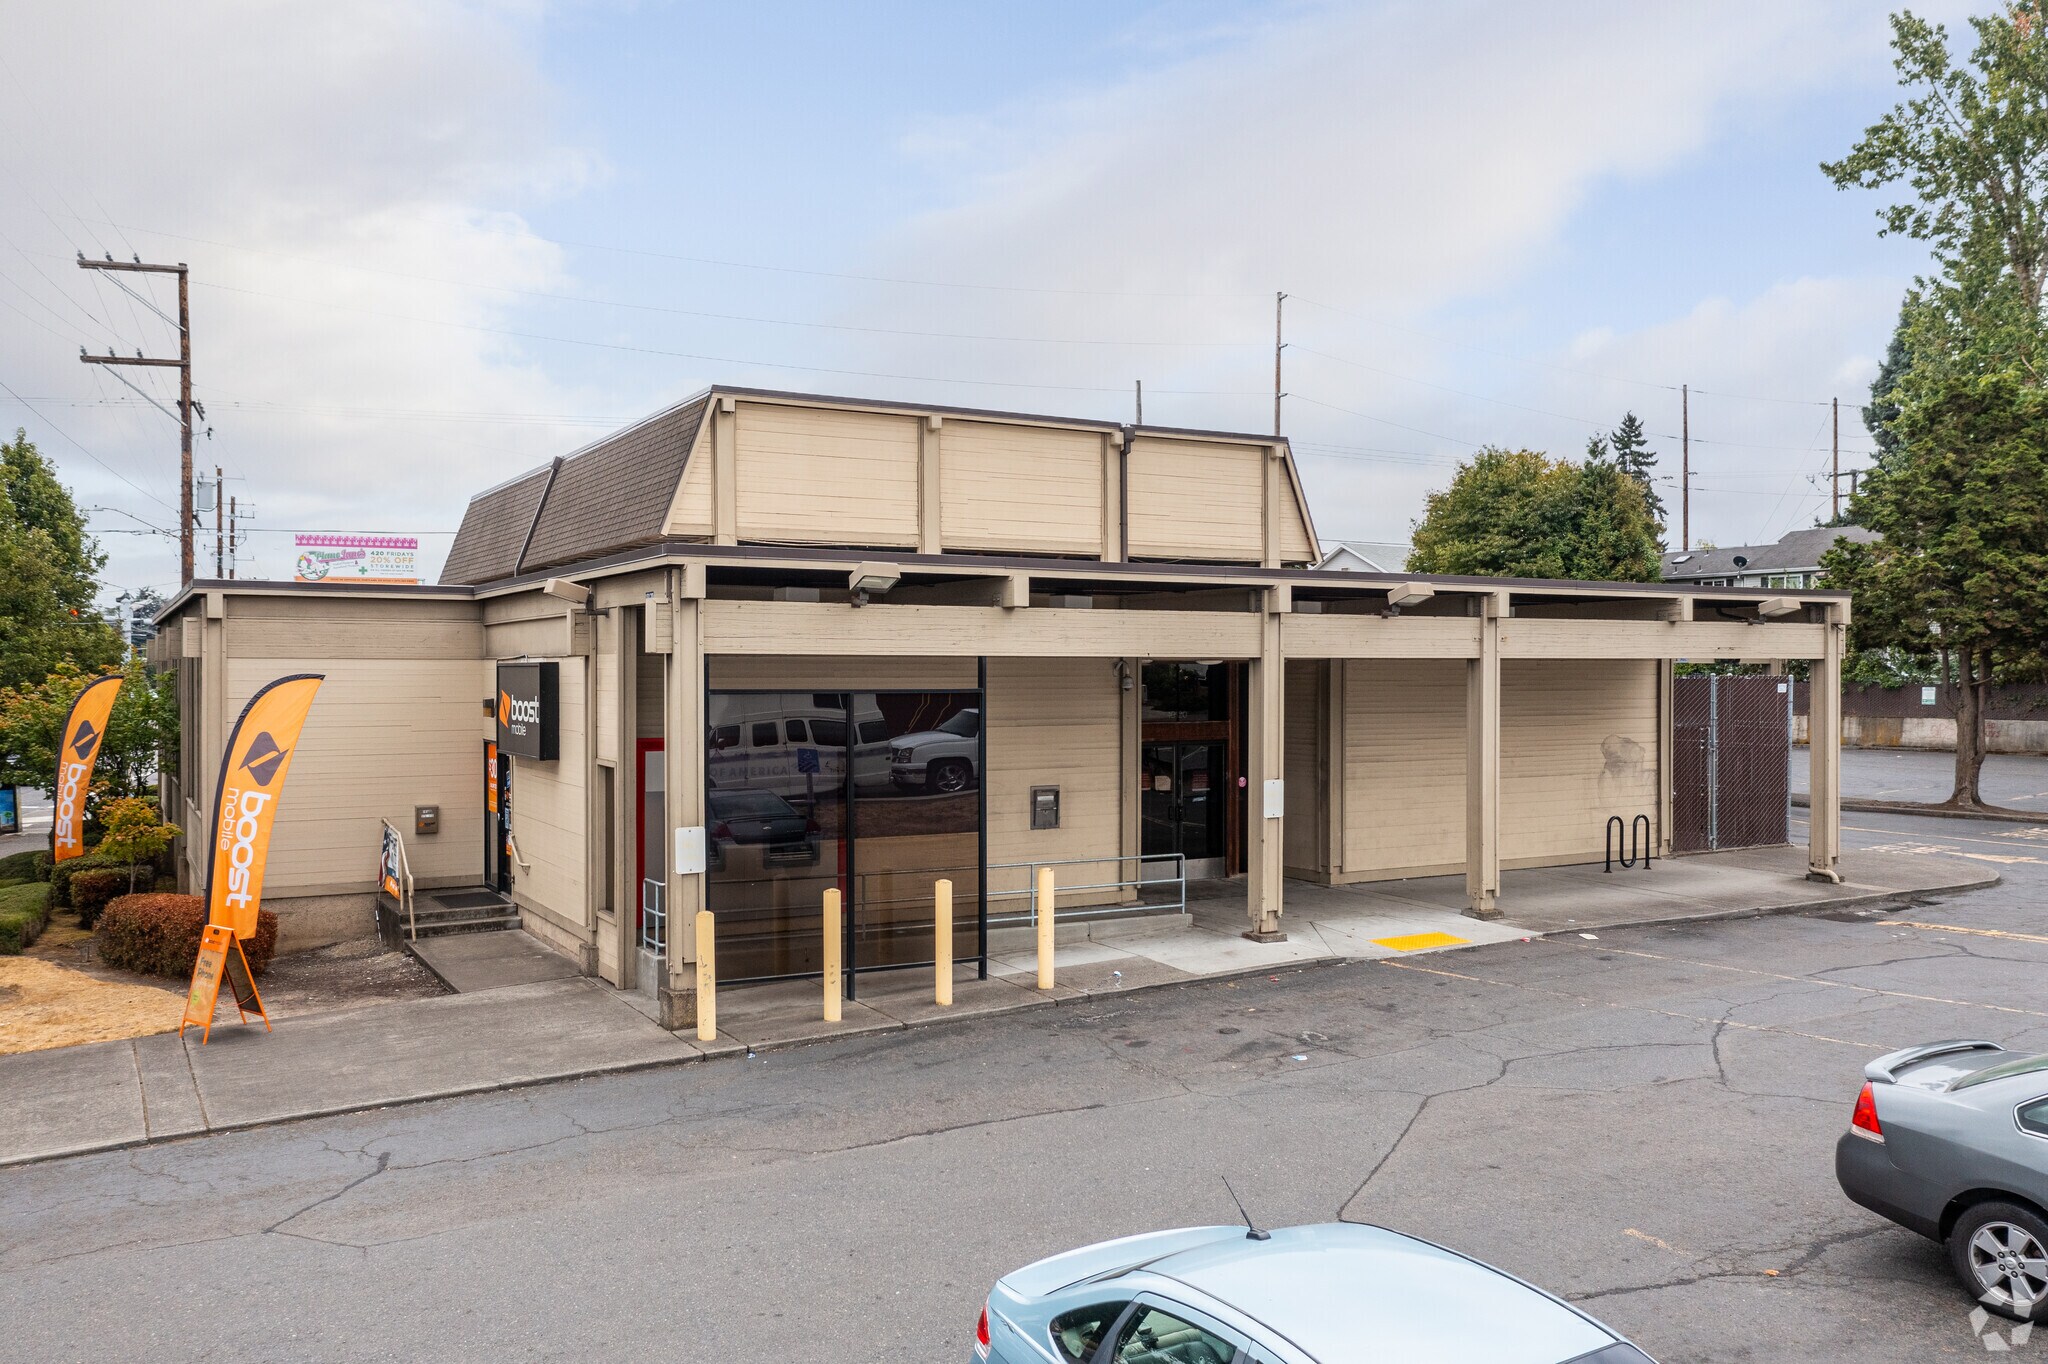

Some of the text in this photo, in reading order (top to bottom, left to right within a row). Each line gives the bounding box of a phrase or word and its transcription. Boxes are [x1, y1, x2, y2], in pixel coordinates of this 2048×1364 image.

[370, 556, 414, 564] 20% OFF
[511, 694, 540, 724] boost
[511, 723, 527, 736] mobile
[728, 765, 788, 778] AMERICA
[57, 763, 88, 849] boost
[221, 788, 239, 850] mobile
[225, 790, 272, 909] boost
